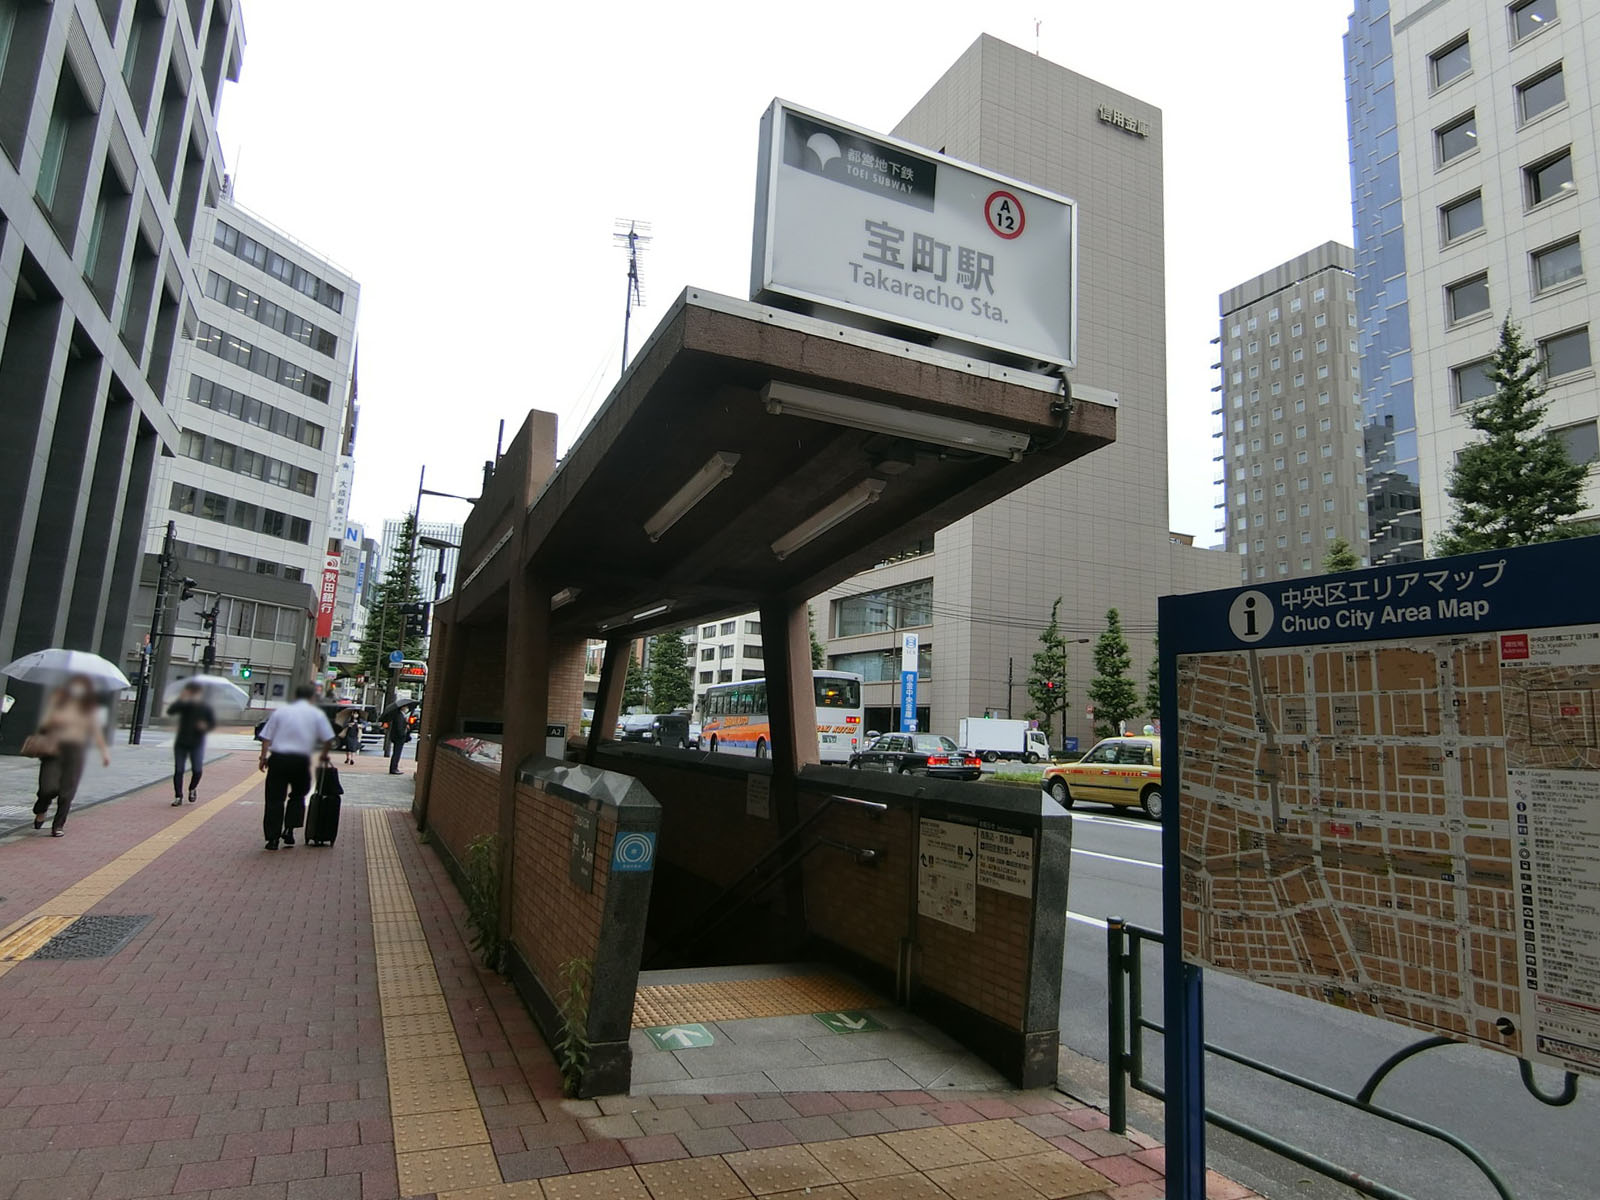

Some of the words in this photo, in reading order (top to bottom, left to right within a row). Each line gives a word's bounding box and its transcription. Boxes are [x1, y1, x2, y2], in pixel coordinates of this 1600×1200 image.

[847, 147, 915, 183] 都営地下鉄
[847, 164, 870, 185] TOEI
[871, 173, 914, 196] SUBWAY
[997, 212, 1014, 230] 12
[999, 200, 1011, 214] A
[862, 218, 995, 296] 宝町駅
[848, 261, 964, 312] Takaracho
[970, 296, 1009, 324] Sta.
[346, 527, 358, 542] N
[320, 572, 337, 614] 秋田銀行
[1281, 559, 1508, 612] 中央区エリアマップ
[1281, 613, 1331, 633] Chuo
[1335, 609, 1375, 630] City
[1380, 604, 1431, 625] Area
[1438, 598, 1490, 620] Map
